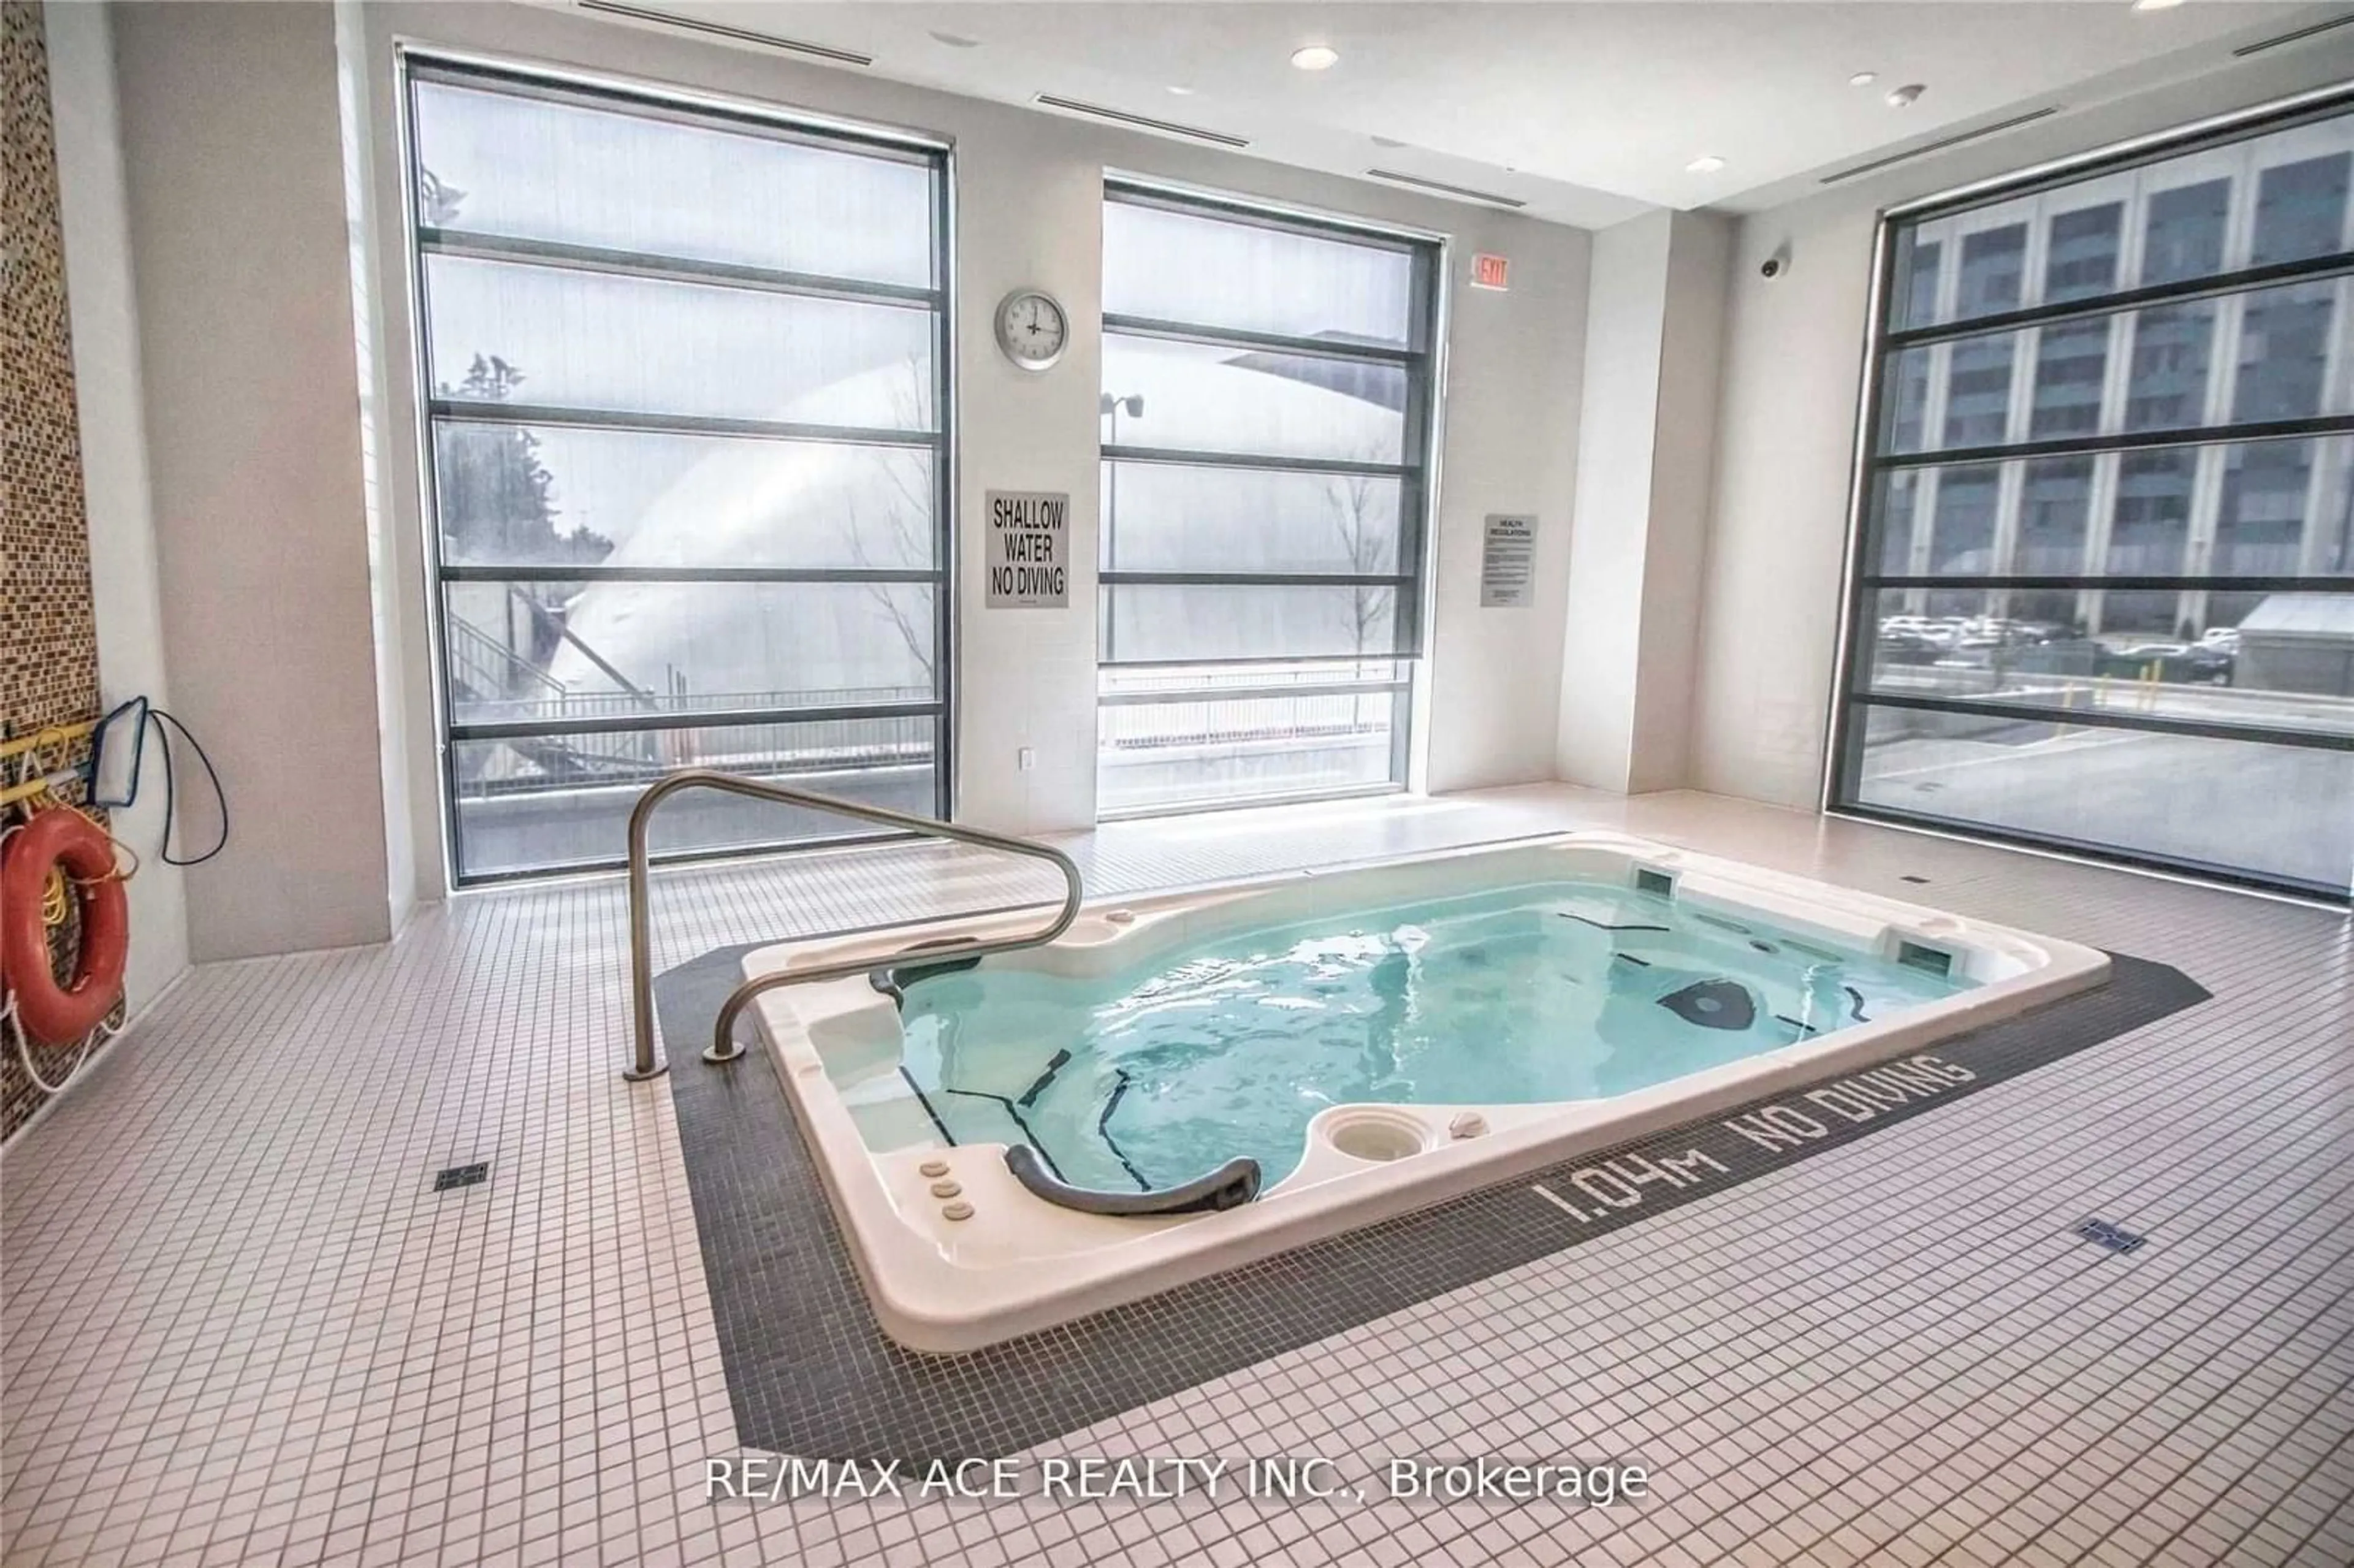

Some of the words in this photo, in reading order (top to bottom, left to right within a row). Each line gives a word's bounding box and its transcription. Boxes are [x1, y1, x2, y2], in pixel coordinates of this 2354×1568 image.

[1482, 257, 1507, 284] EXIT
[993, 498, 1064, 530] SHALLOW
[1004, 533, 1053, 562] WATER
[992, 566, 1013, 595] NO
[1018, 566, 1064, 595] DIVING
[1724, 1105, 1830, 1152] NO
[1804, 1054, 1977, 1123] DIVING
